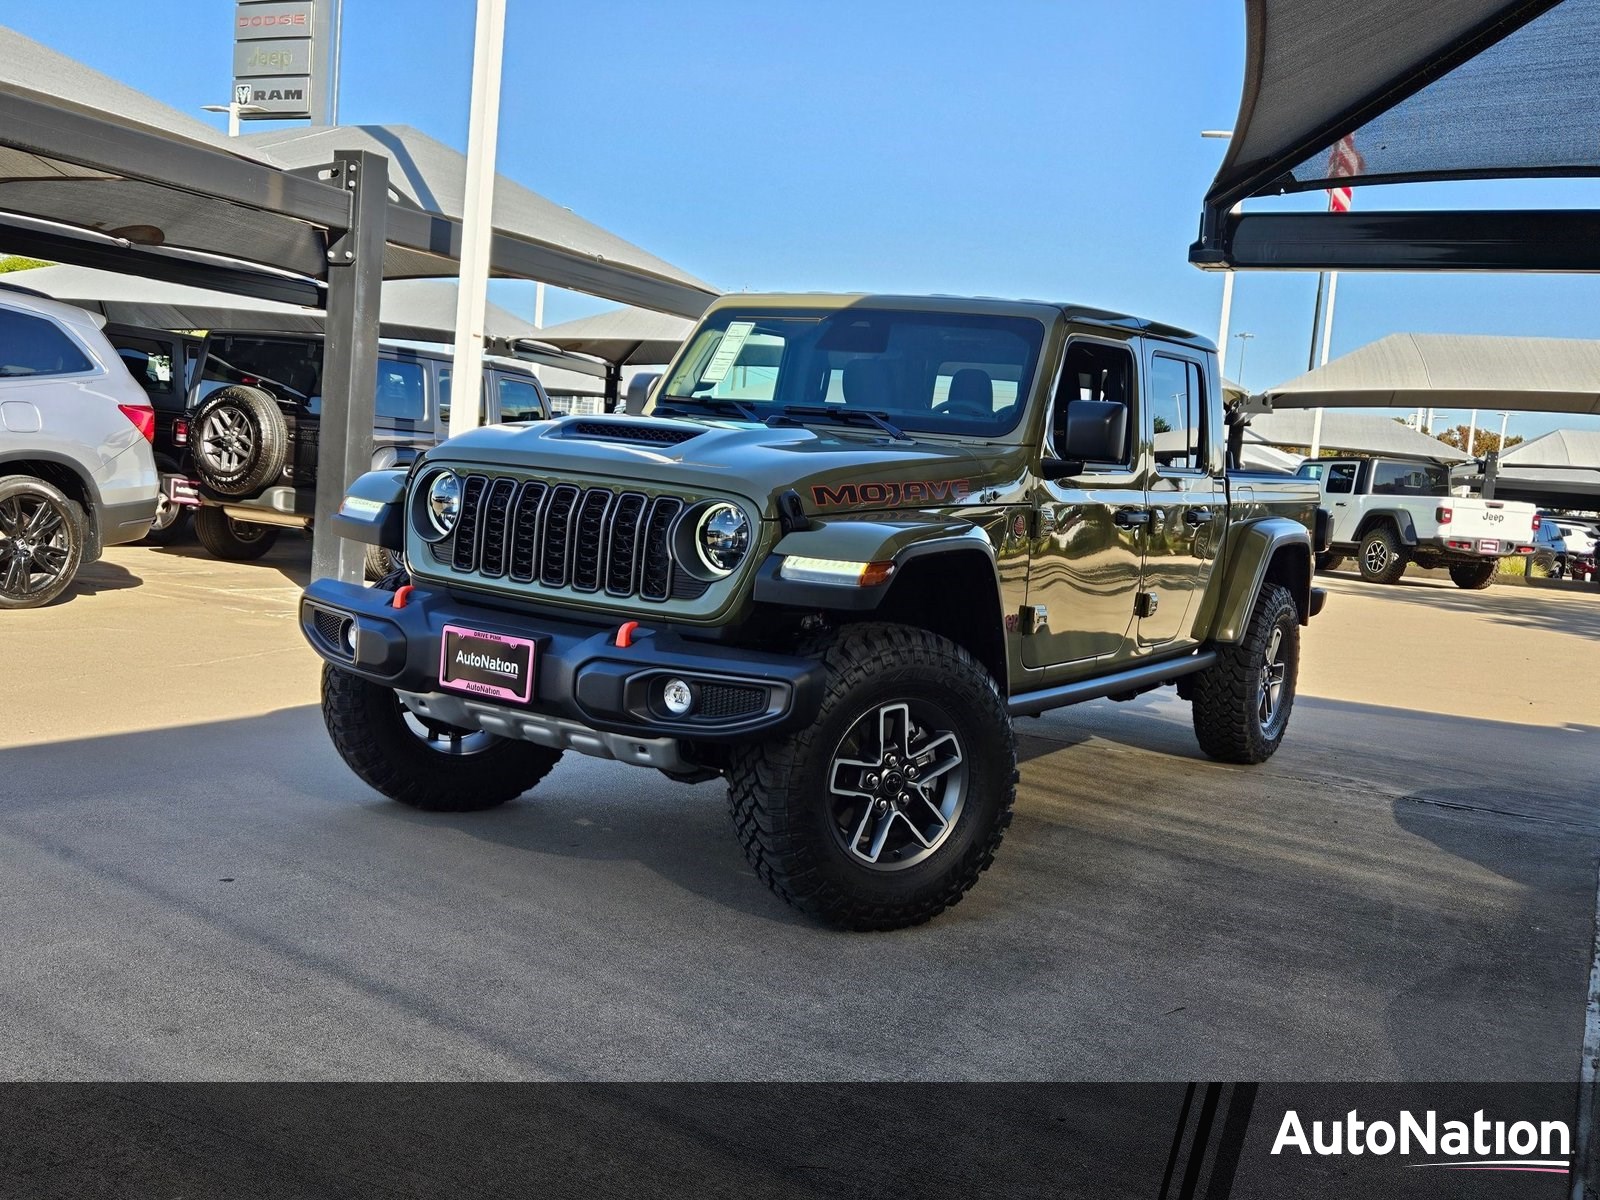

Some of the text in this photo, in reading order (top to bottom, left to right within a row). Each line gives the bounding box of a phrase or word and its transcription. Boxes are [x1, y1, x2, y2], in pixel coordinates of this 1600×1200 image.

[239, 14, 305, 27] DODGE
[248, 47, 293, 70] Jeep
[253, 89, 303, 101] RAM
[811, 480, 970, 507] MOJAVE
[1482, 511, 1504, 523] Jeep
[473, 631, 489, 639] DRIVE
[455, 649, 519, 675] AutoNation
[465, 682, 501, 696] AutoNation
